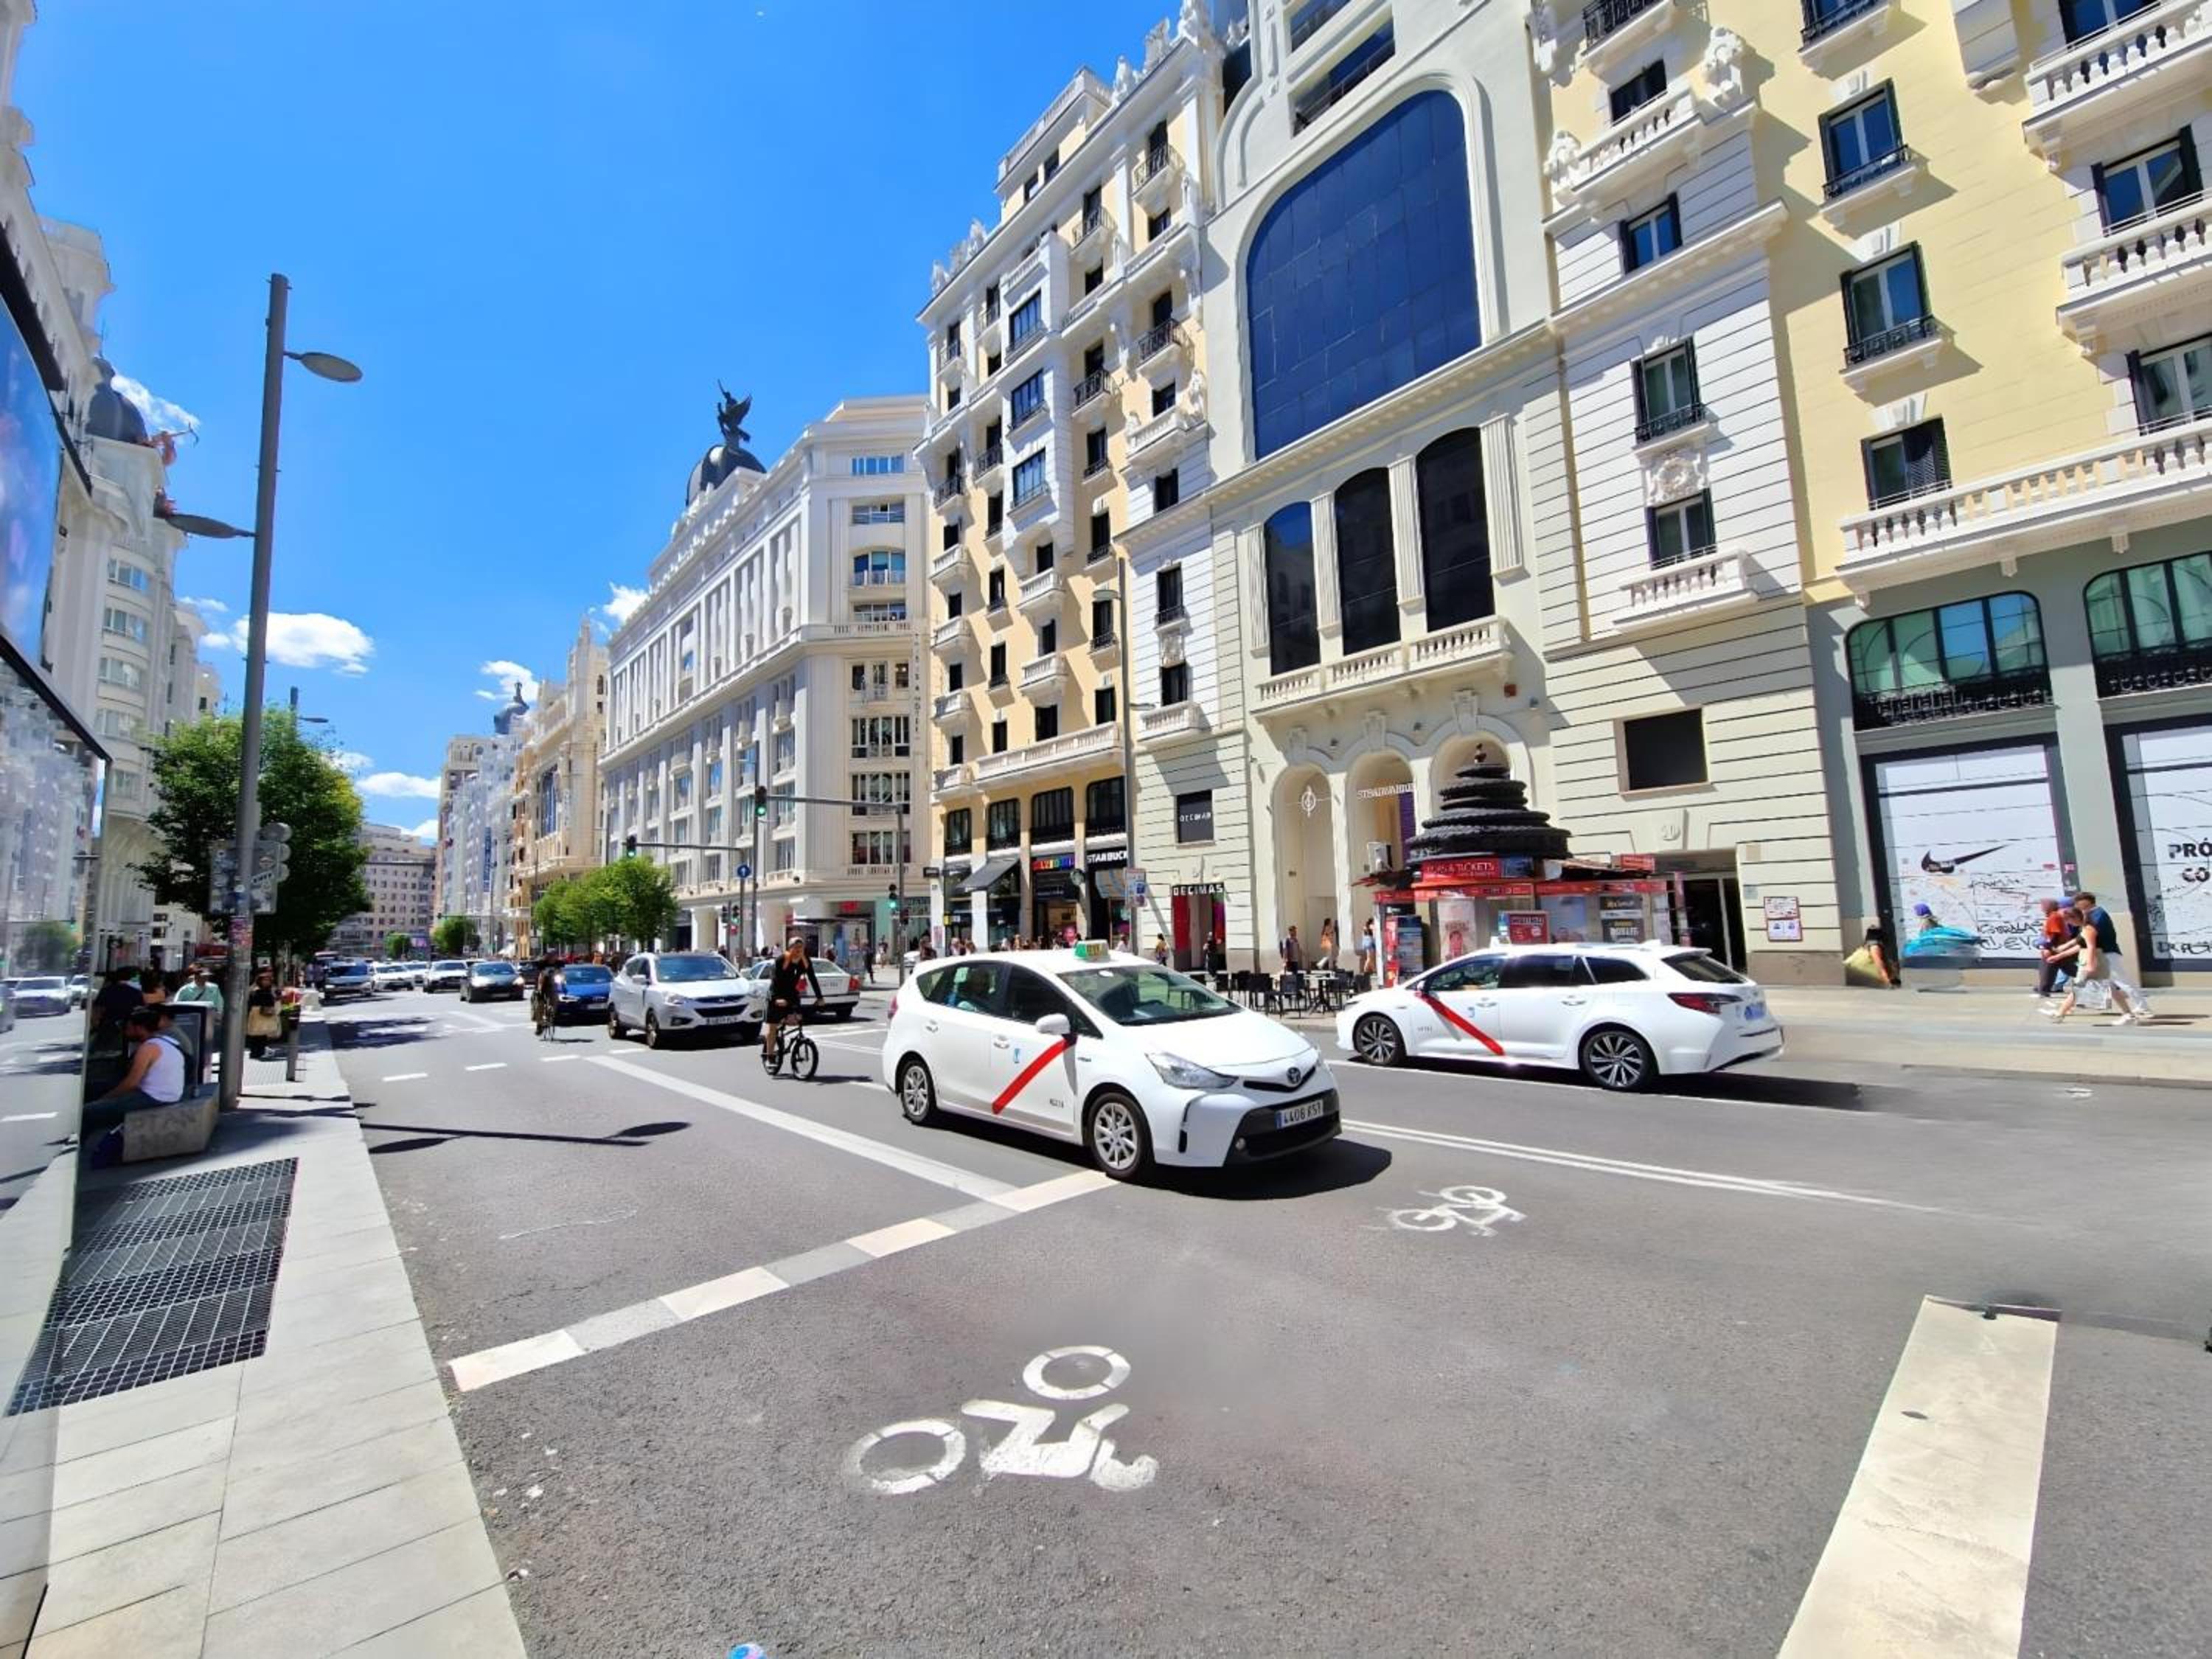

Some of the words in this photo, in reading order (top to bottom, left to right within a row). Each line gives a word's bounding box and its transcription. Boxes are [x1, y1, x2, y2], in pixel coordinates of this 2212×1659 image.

[2168, 838, 2212, 858] PRÓ
[1086, 850, 1128, 863] STARBUCK
[1173, 884, 1224, 896] DECIMAS
